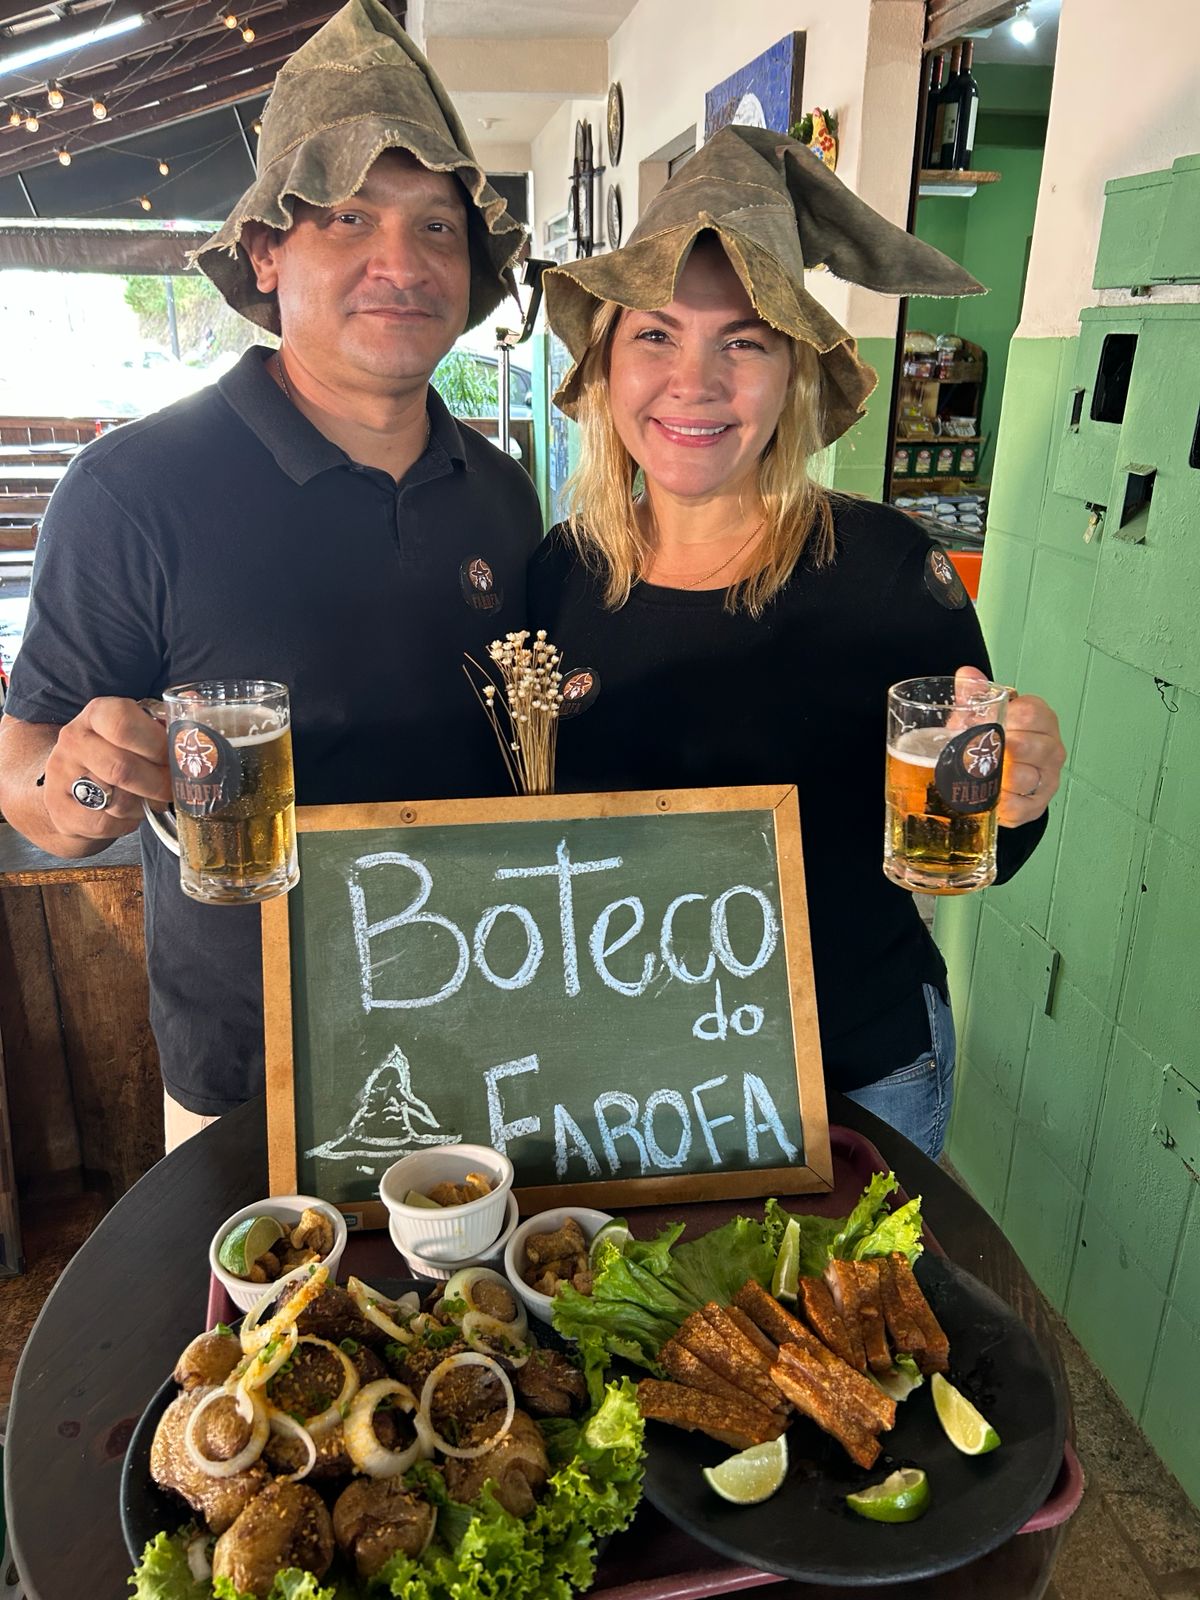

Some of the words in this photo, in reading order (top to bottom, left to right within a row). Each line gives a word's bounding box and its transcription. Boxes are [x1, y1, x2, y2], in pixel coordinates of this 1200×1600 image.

[345, 837, 780, 1014] Boteco
[692, 978, 764, 1041] do
[484, 1053, 799, 1176] FAROFA
